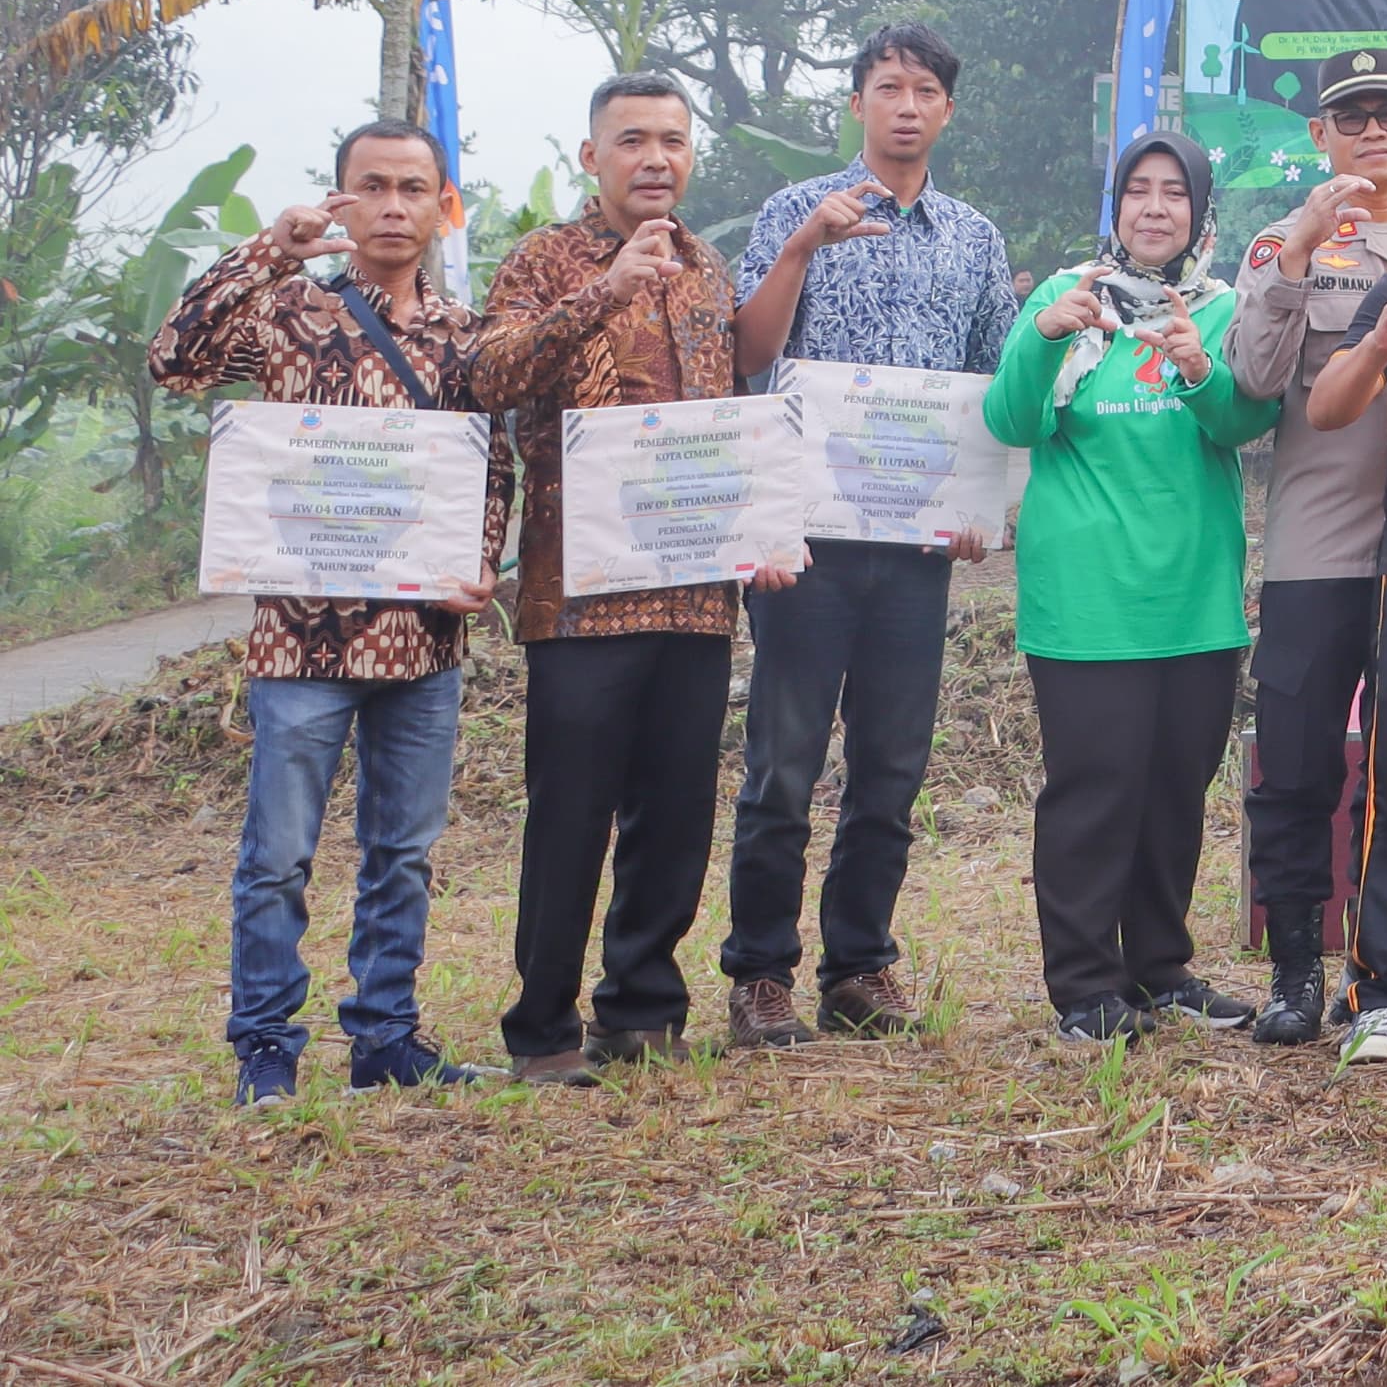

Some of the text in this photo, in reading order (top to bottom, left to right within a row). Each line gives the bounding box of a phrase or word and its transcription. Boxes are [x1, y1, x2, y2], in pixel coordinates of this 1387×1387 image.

[843, 394, 950, 412] PEMERINTAH DAERAH
[1096, 399, 1131, 415] Dinas
[864, 411, 928, 424] KOTA CIMAHI
[289, 438, 414, 453] PEMERINTAH DAERAH
[633, 431, 741, 449] PEMERINTAH DAERAH
[313, 454, 389, 467] KOTA CIMAHI
[655, 448, 720, 462] KOTA CIMAHI
[858, 455, 877, 465] RW
[889, 458, 927, 469] UTAMA
[861, 481, 920, 494] PERINGATAN
[636, 493, 740, 512] RW 09 SETIAMANAH
[833, 493, 944, 509] HARI LINGKUNGAN HIDUP
[292, 503, 402, 517] RW 04 CIPAGERAN
[861, 508, 916, 519] TAHUN 2024
[657, 523, 717, 536] PERINGATAN
[309, 532, 378, 544] PERINGATAN
[631, 533, 744, 553] HARI LINGKUNGAN HIDUP
[276, 545, 409, 560] HARI LINGKUNGAN HIDUP
[661, 549, 716, 563] TAHUN 2024
[310, 561, 376, 573] TAHUN 2024
